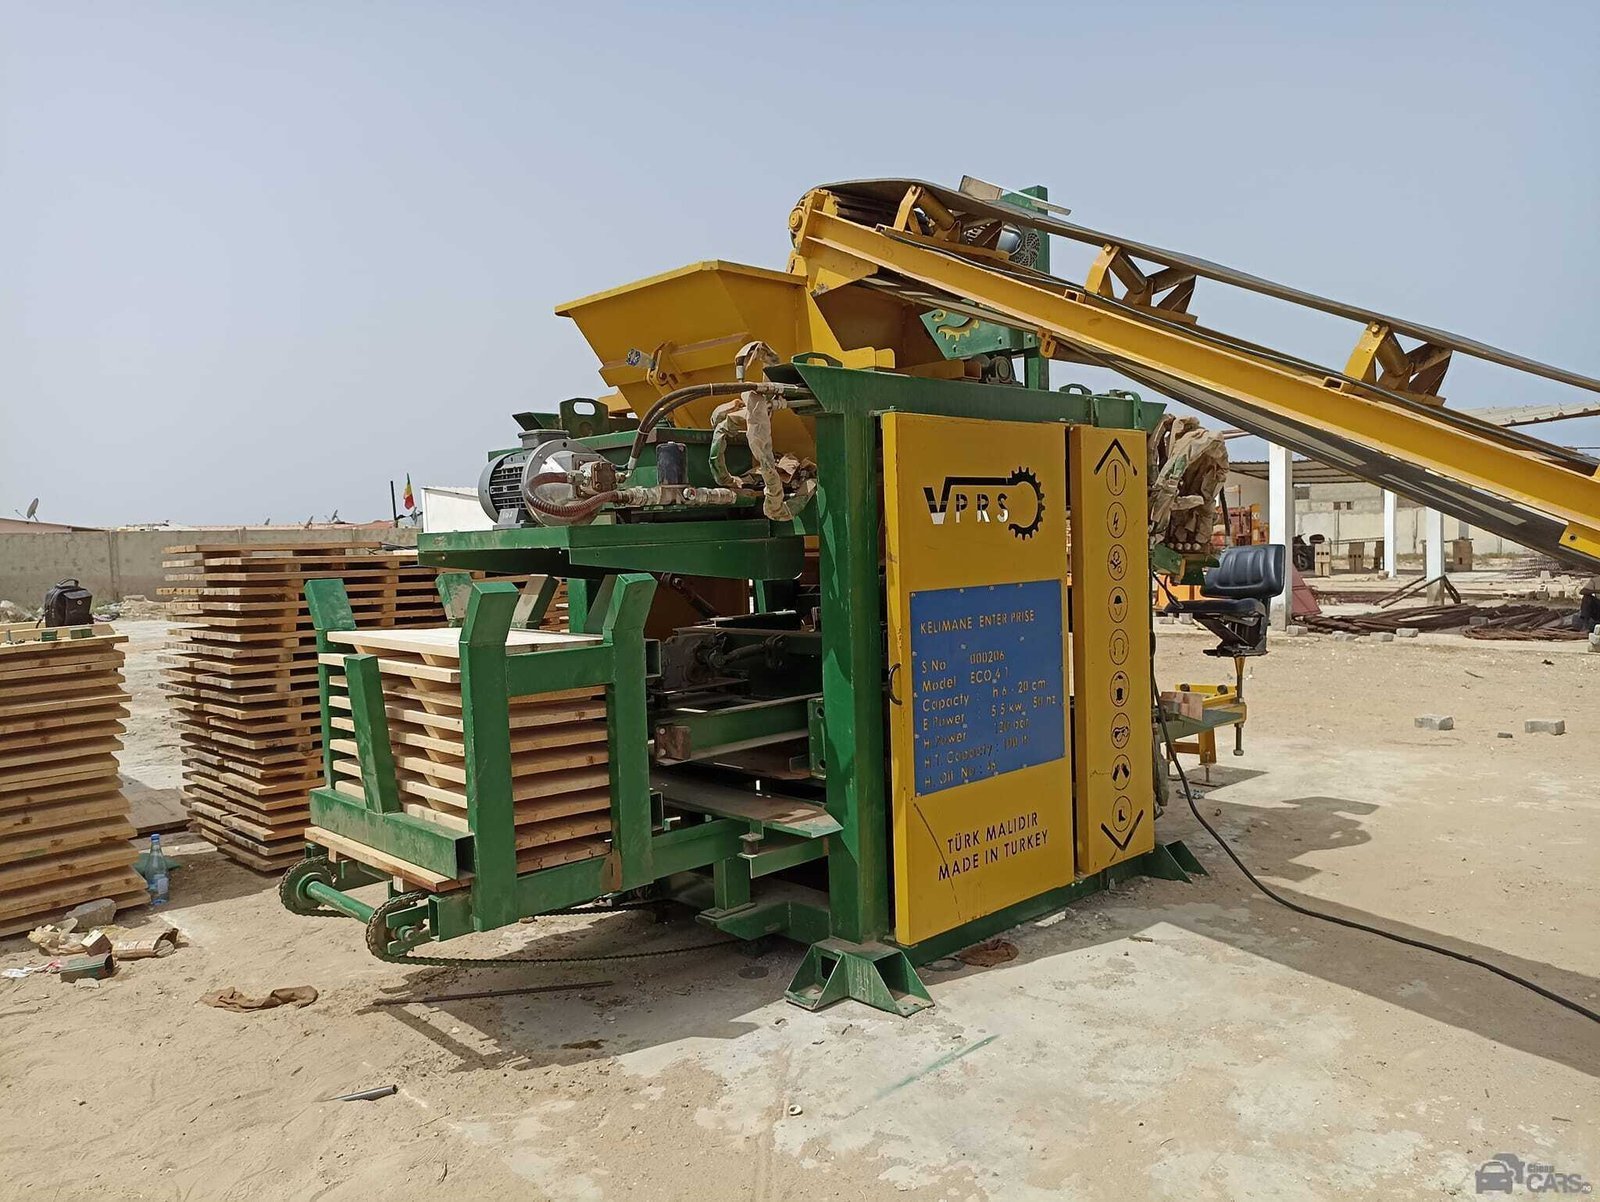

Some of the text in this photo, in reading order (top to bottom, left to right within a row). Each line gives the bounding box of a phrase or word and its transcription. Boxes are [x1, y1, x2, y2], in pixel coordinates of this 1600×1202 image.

[920, 616, 972, 635] KELIMANE
[922, 675, 956, 692] Model
[947, 830, 980, 854] TÜRK
[938, 829, 1049, 881] MADE IN TURKEY
